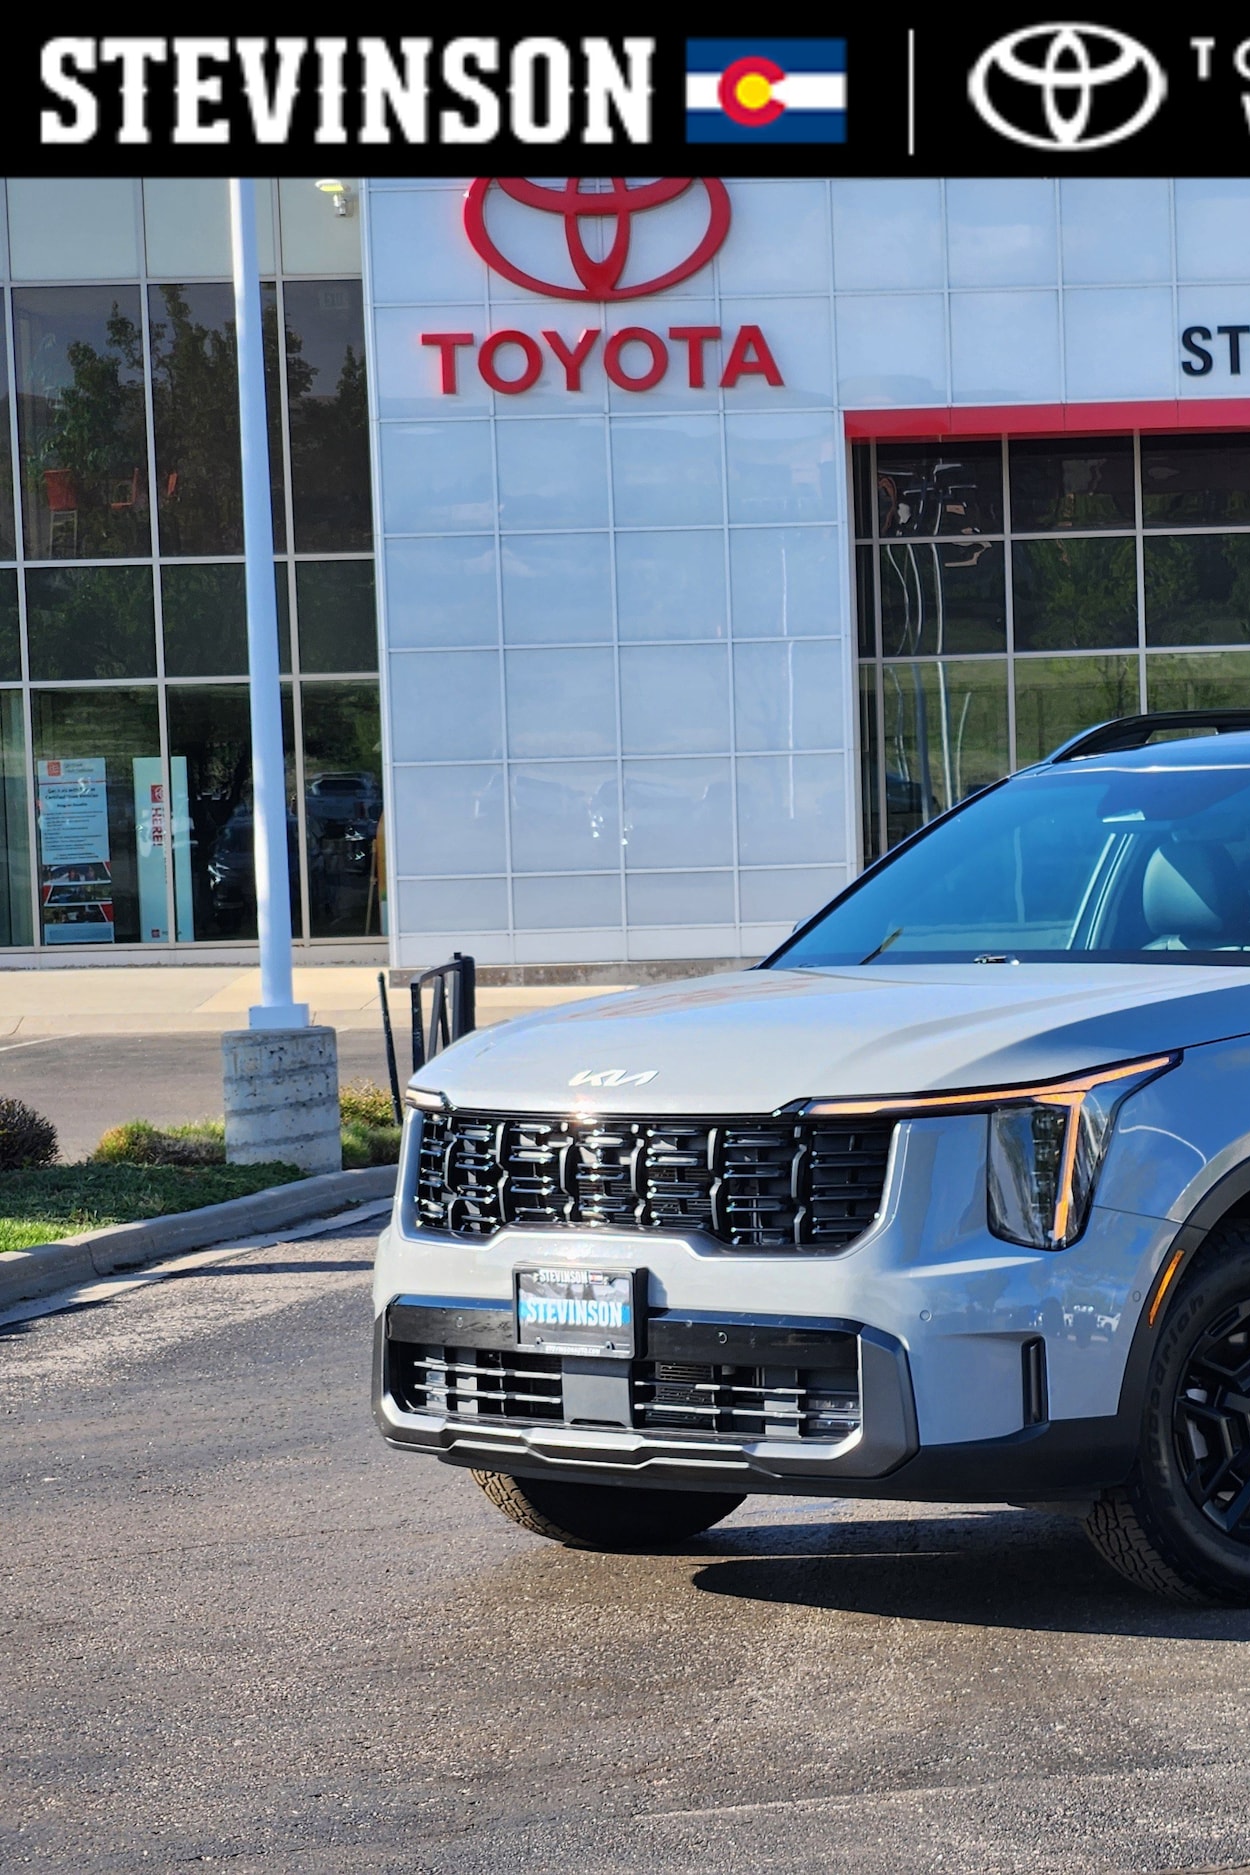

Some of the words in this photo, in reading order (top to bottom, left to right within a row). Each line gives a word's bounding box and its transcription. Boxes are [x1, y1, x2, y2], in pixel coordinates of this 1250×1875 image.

[420, 325, 784, 394] TOYOTA
[152, 807, 164, 847] HERE!
[568, 1069, 660, 1087] KIA
[538, 1269, 590, 1285] STEVINSON
[526, 1298, 624, 1328] STEVINSON
